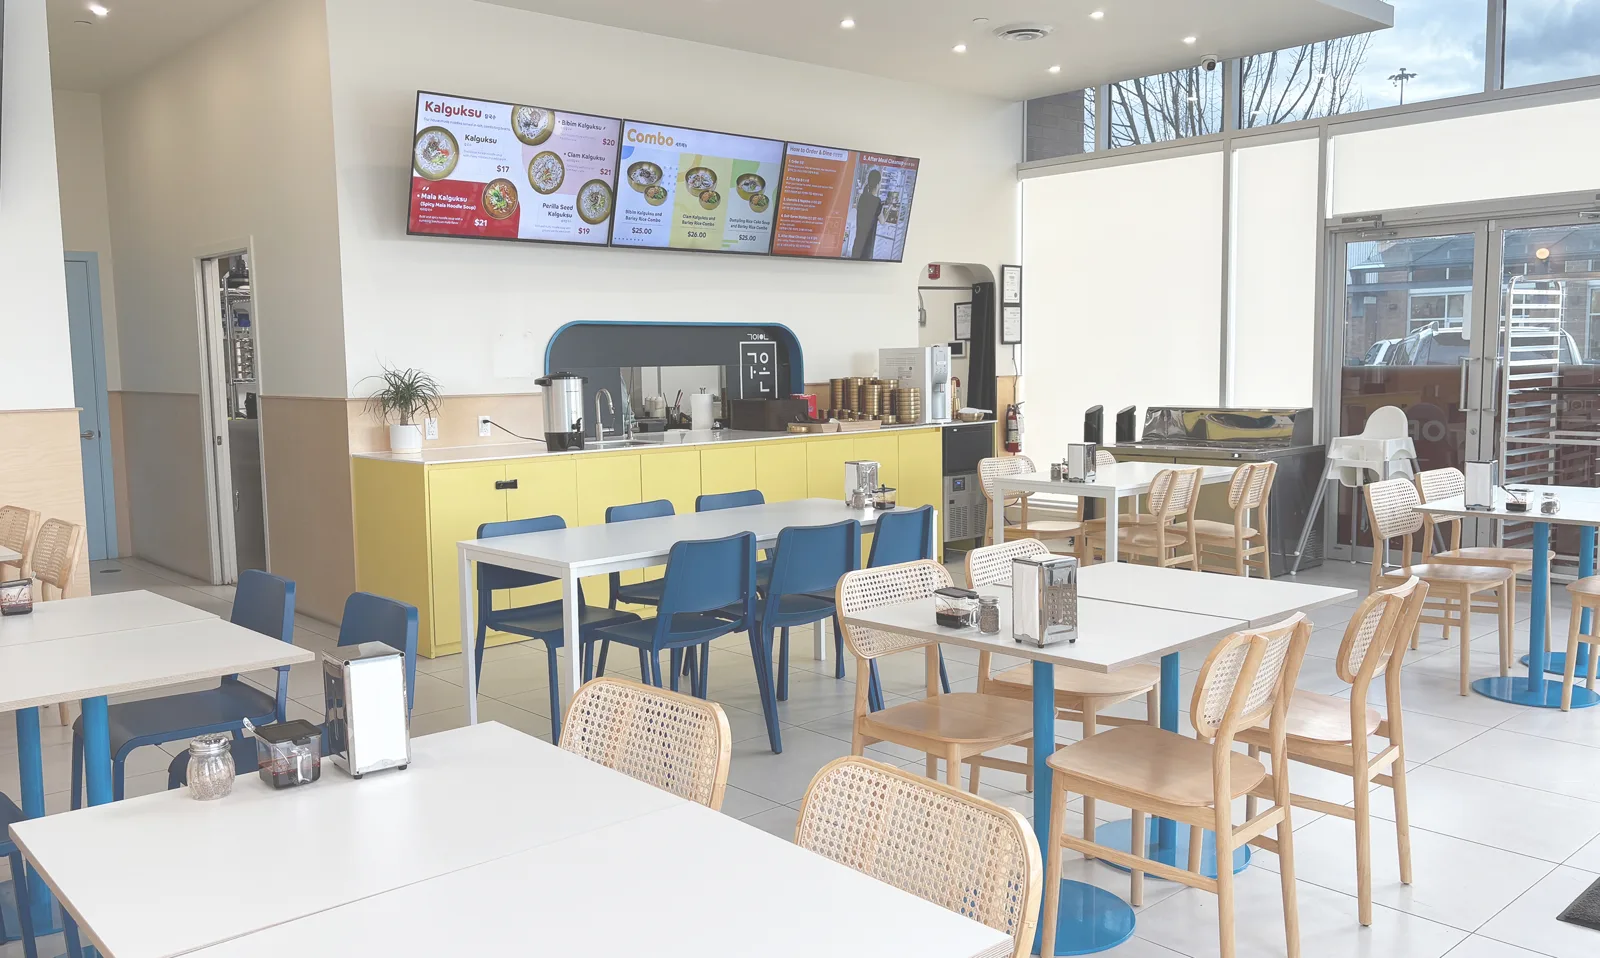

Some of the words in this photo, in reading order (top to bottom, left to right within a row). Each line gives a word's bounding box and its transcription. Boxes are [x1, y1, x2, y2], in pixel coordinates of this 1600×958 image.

[425, 101, 482, 118] Kalguksu
[578, 122, 603, 131] Kalguksu
[465, 134, 497, 144] Kalguksu
[627, 128, 674, 147] Combo
[602, 138, 616, 147] $20
[567, 151, 580, 159] Clam
[582, 153, 606, 162] Kalguksu
[496, 164, 510, 173] $17
[600, 167, 612, 176] $21
[421, 192, 437, 200] Mala
[438, 194, 468, 203] Kalguksu
[542, 202, 560, 210] Perilla
[547, 210, 573, 219] Kalguksu
[474, 218, 488, 227] $21
[578, 227, 591, 235] $19
[632, 226, 653, 235] $25.00
[687, 230, 707, 239] $26.00
[738, 234, 757, 242] $25.00
